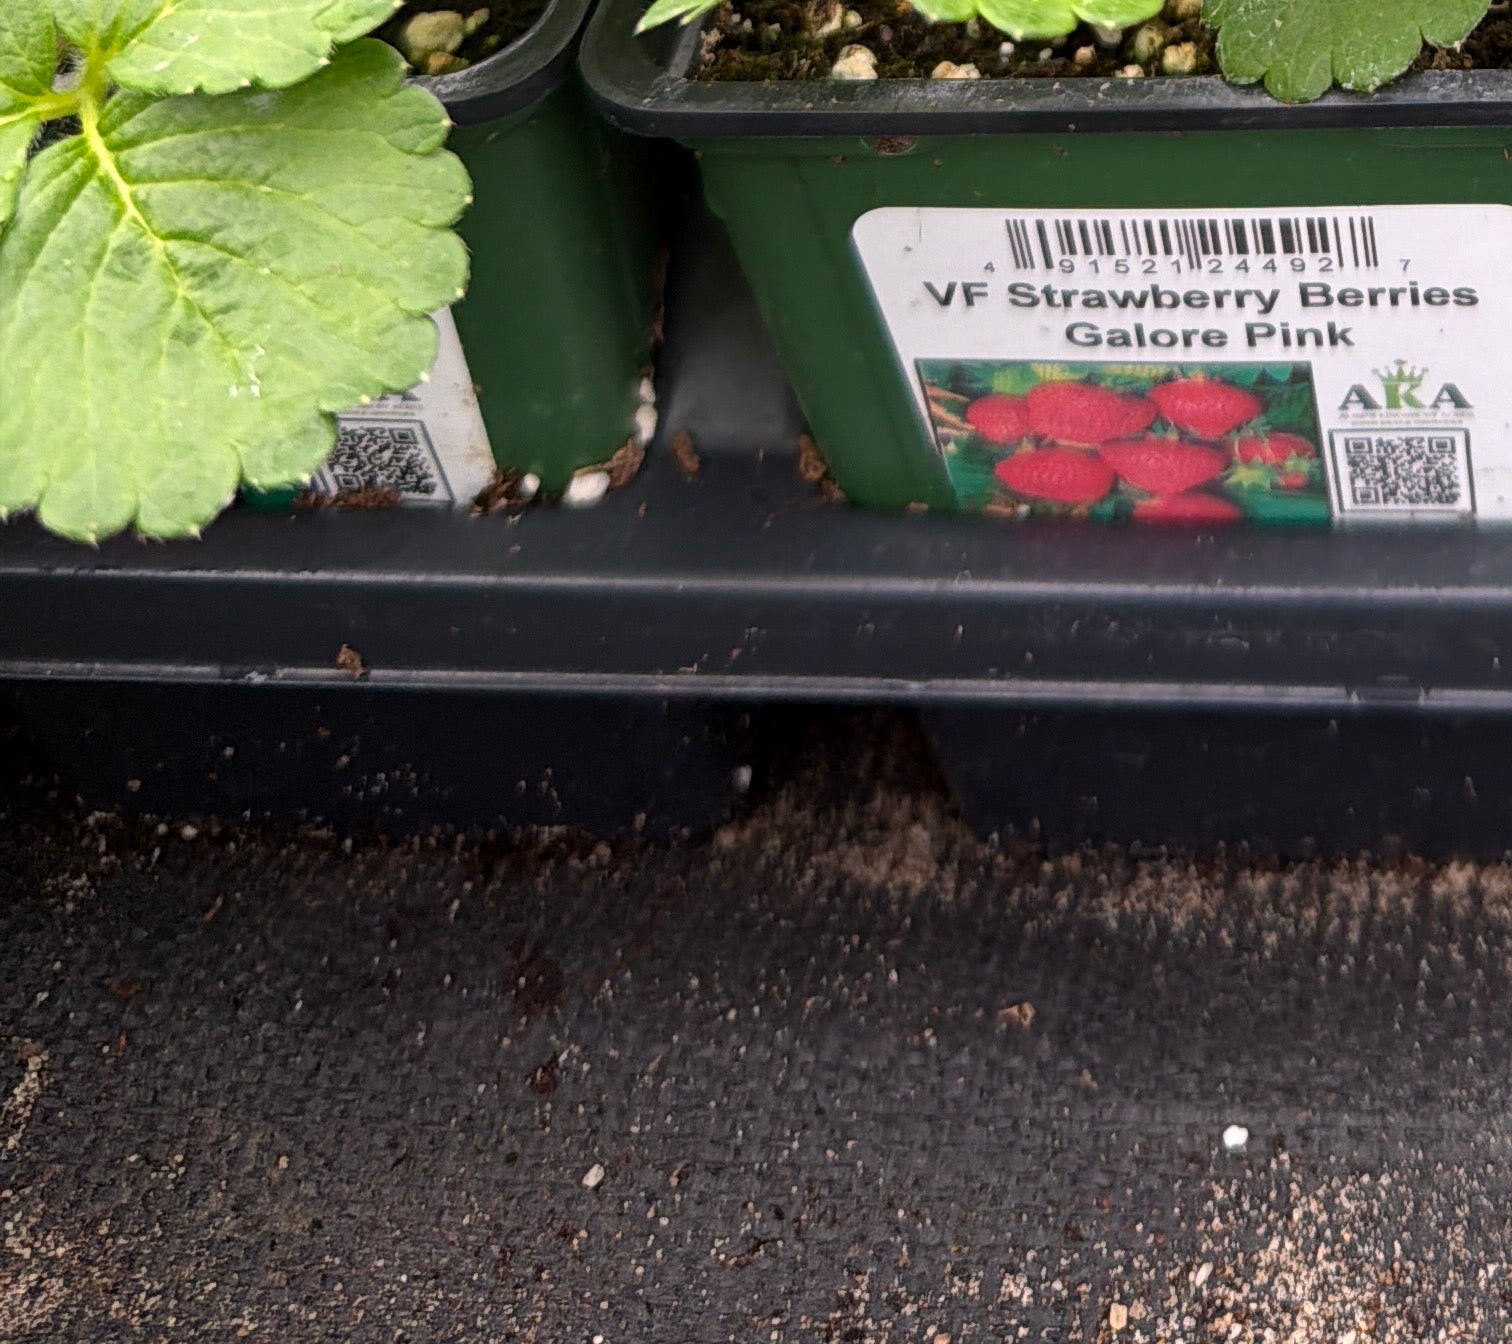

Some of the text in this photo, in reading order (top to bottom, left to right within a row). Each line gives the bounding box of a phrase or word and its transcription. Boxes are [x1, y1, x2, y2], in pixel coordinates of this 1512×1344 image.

[1058, 258, 1184, 275] 91521
[1207, 257, 1335, 275] 24492
[923, 281, 1481, 314] VF Strawberry Berries
[1064, 321, 1357, 349] Galore Pink
[1338, 378, 1475, 410] AKA
